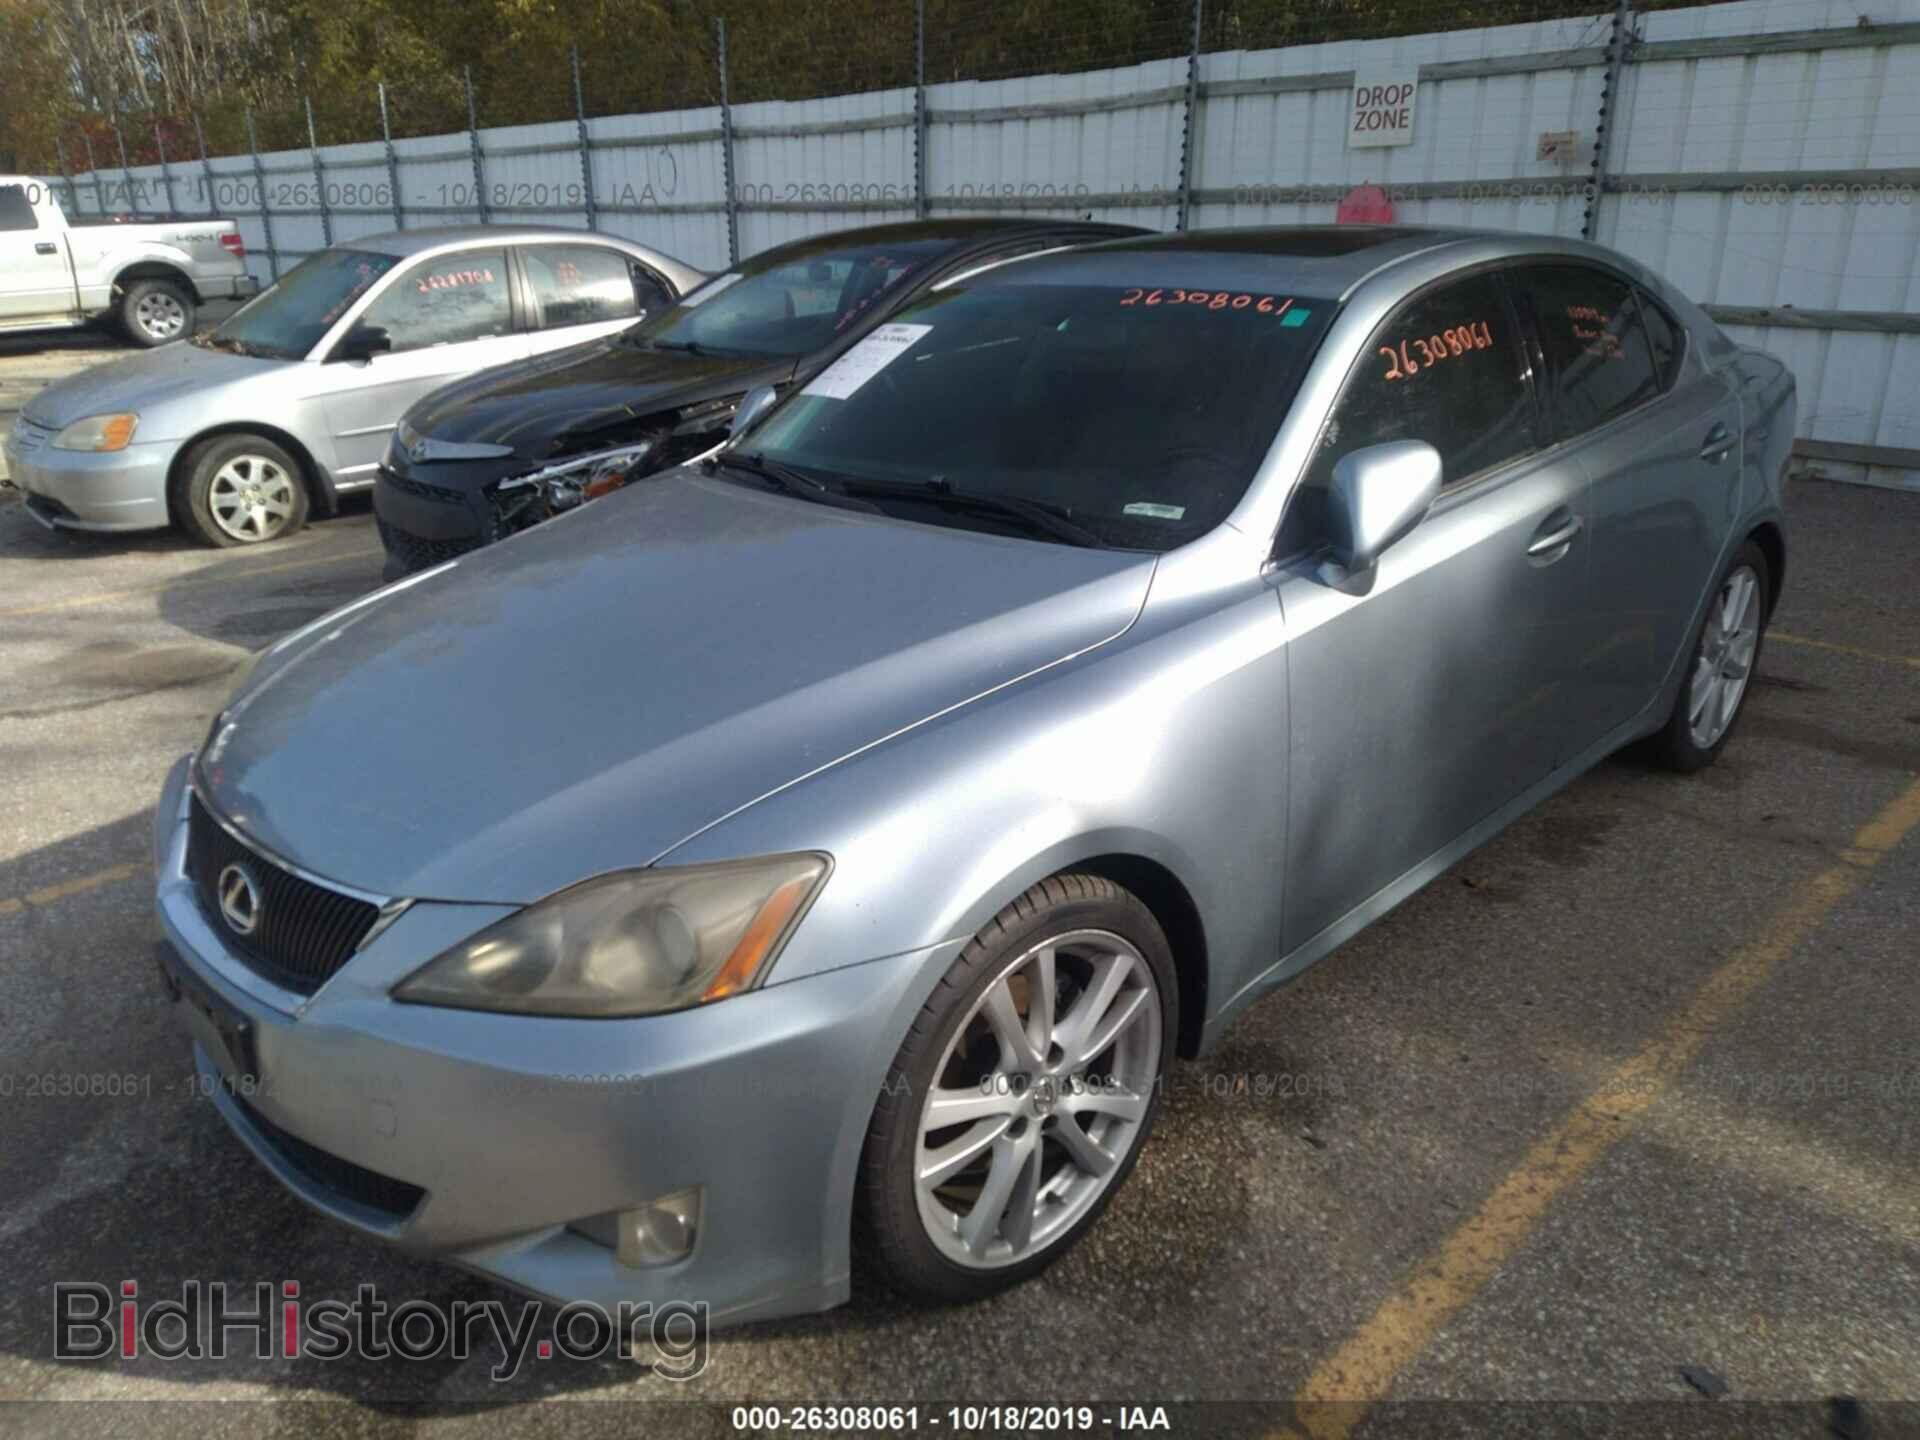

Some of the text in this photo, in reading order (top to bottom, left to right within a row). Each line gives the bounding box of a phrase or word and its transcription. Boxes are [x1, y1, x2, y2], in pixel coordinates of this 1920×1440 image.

[1356, 83, 1414, 108] DROP
[1354, 108, 1410, 131] ZONE
[1120, 288, 1293, 316] 26308061
[1380, 321, 1493, 379] 26308061
